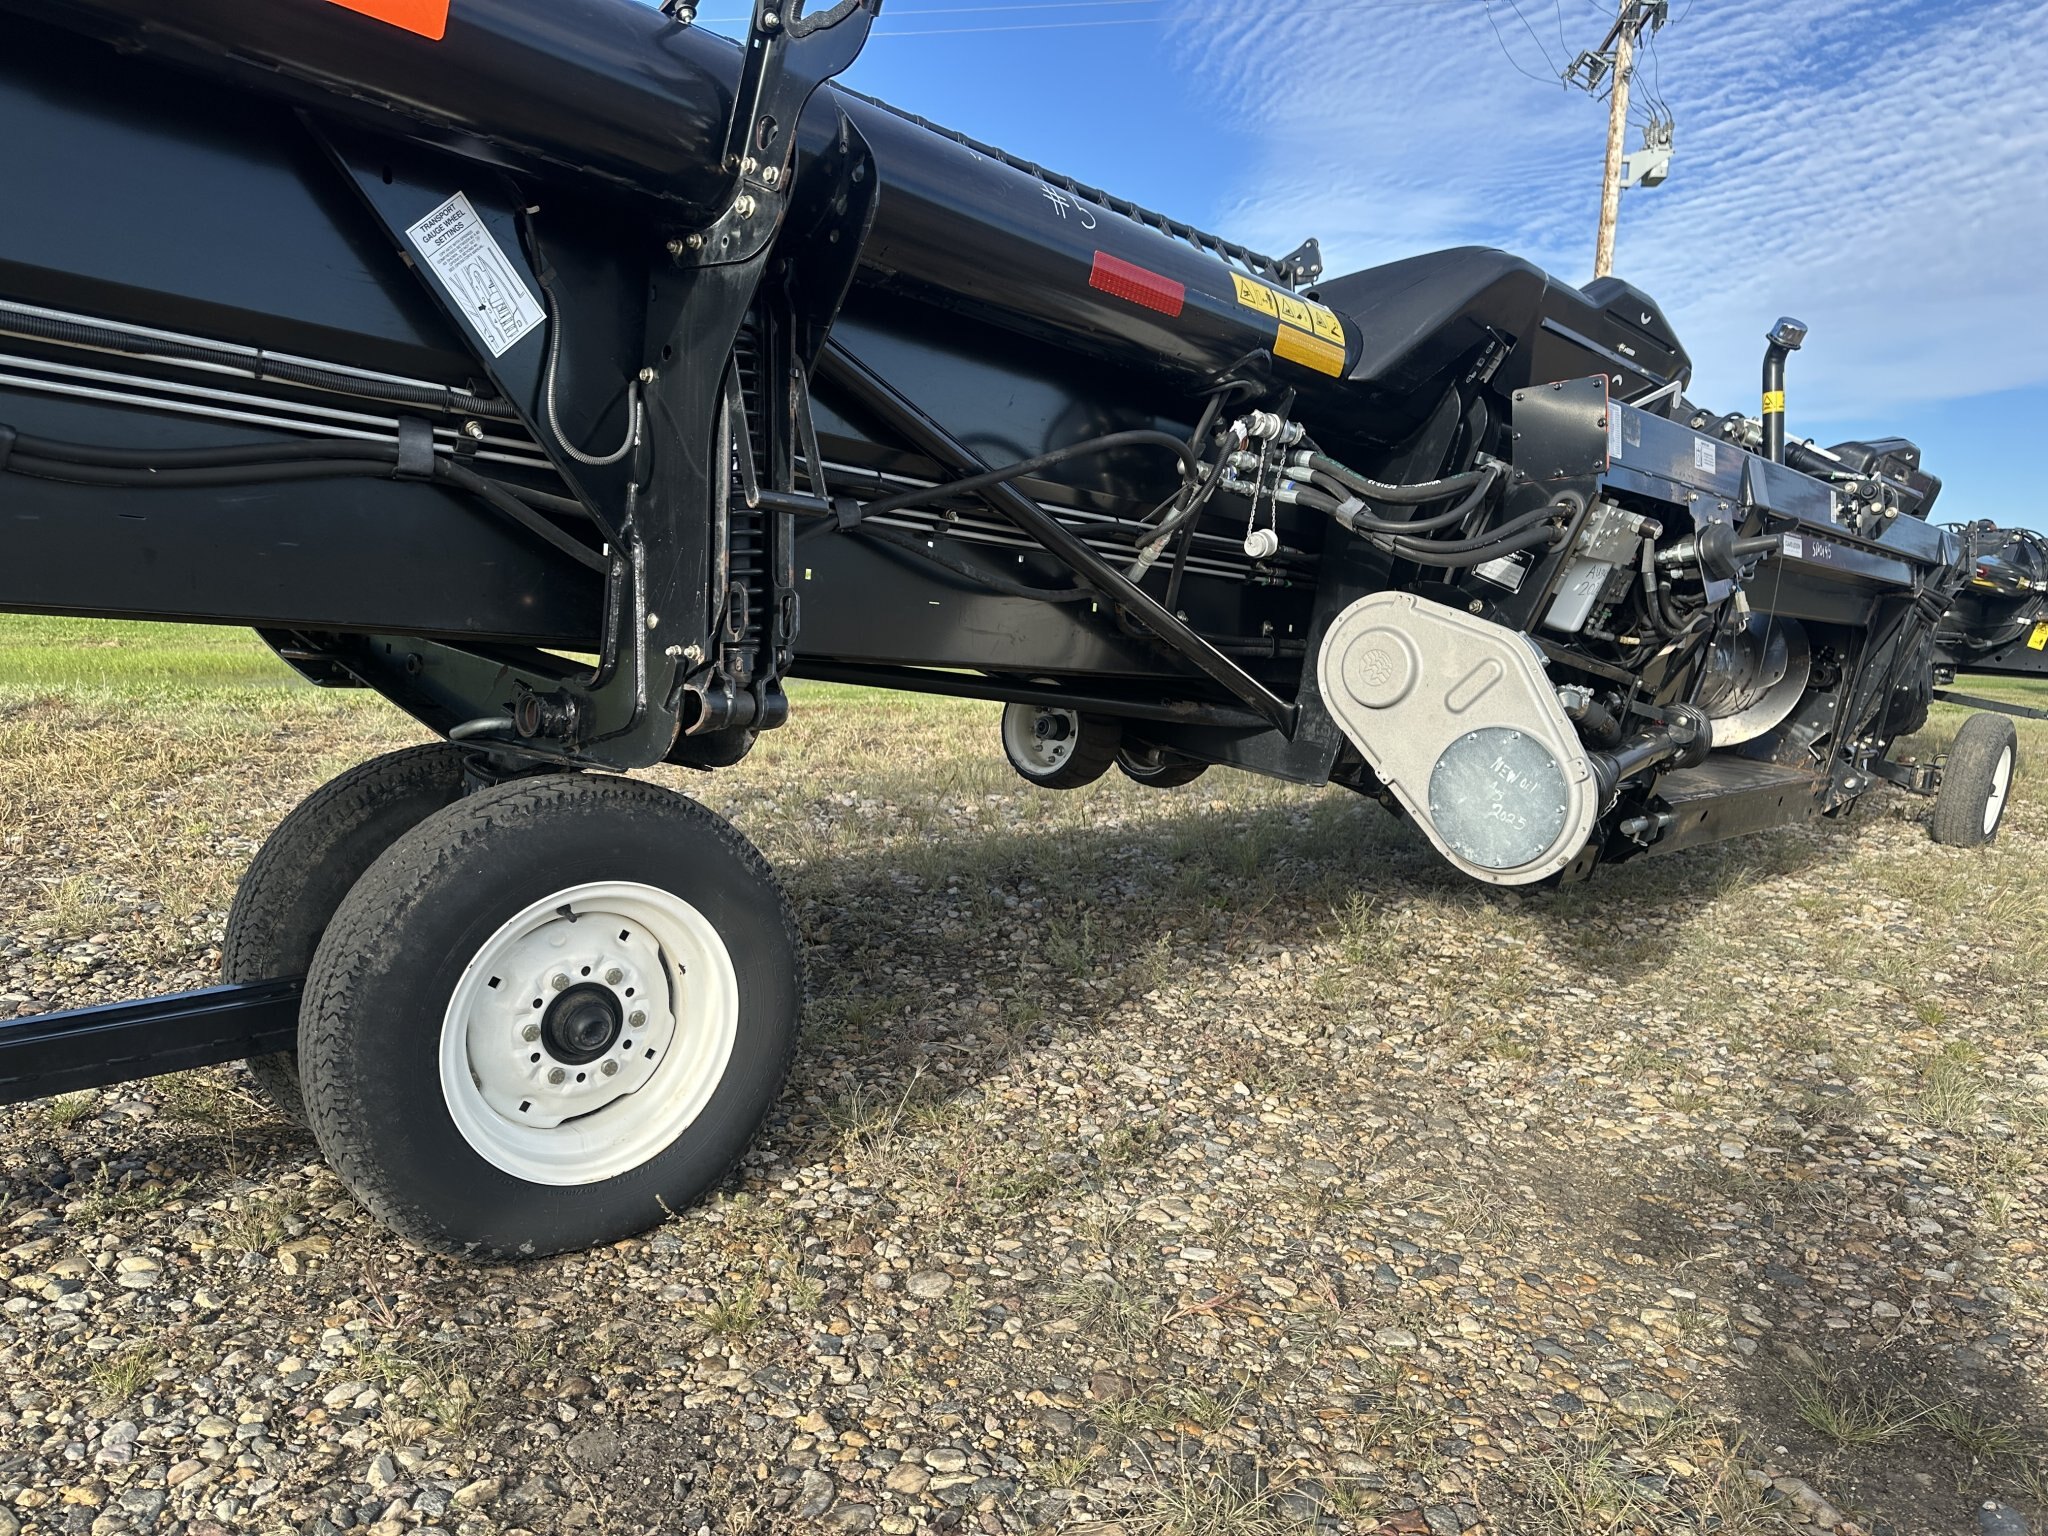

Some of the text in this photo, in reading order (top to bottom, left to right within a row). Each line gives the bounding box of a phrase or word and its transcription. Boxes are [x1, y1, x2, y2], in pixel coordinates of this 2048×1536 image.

[420, 203, 456, 232] TRANSPORT
[422, 209, 466, 243] GAUGE WHEEL
[434, 222, 464, 246] SETTINGS
[1487, 803, 1527, 831] 2025
